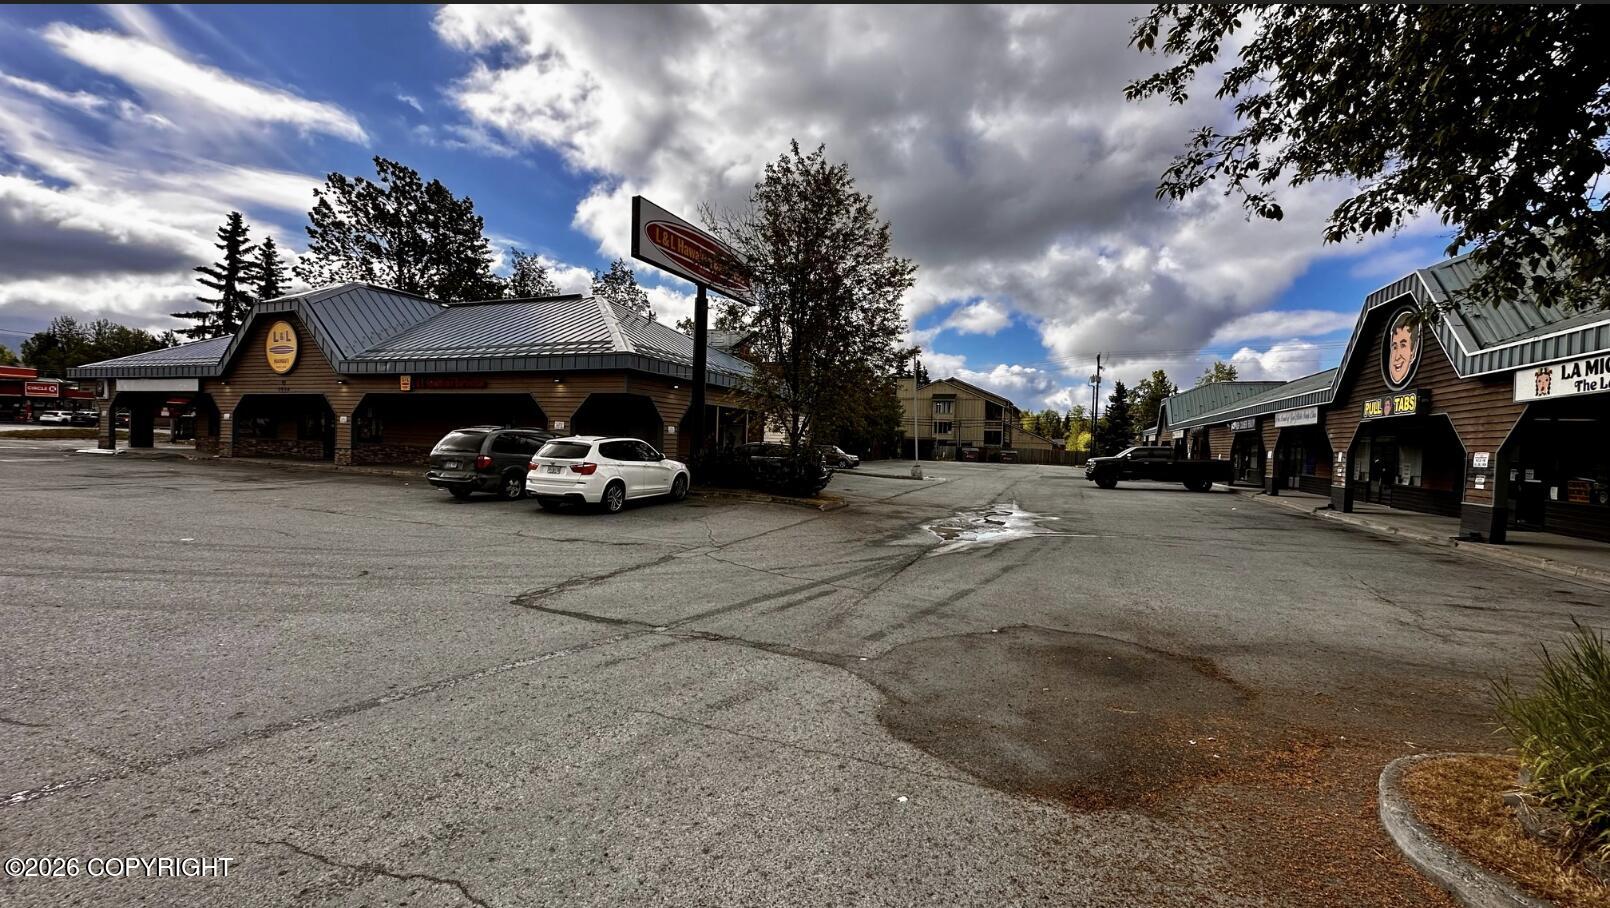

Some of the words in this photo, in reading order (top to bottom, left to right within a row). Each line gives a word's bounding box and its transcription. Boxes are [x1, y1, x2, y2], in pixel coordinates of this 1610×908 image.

[656, 227, 676, 250] L&L
[1561, 362, 1581, 380] LA
[1574, 378, 1597, 392] The
[1600, 376, 1610, 389] L
[1363, 400, 1382, 417] PULL
[1394, 394, 1416, 414] TABS
